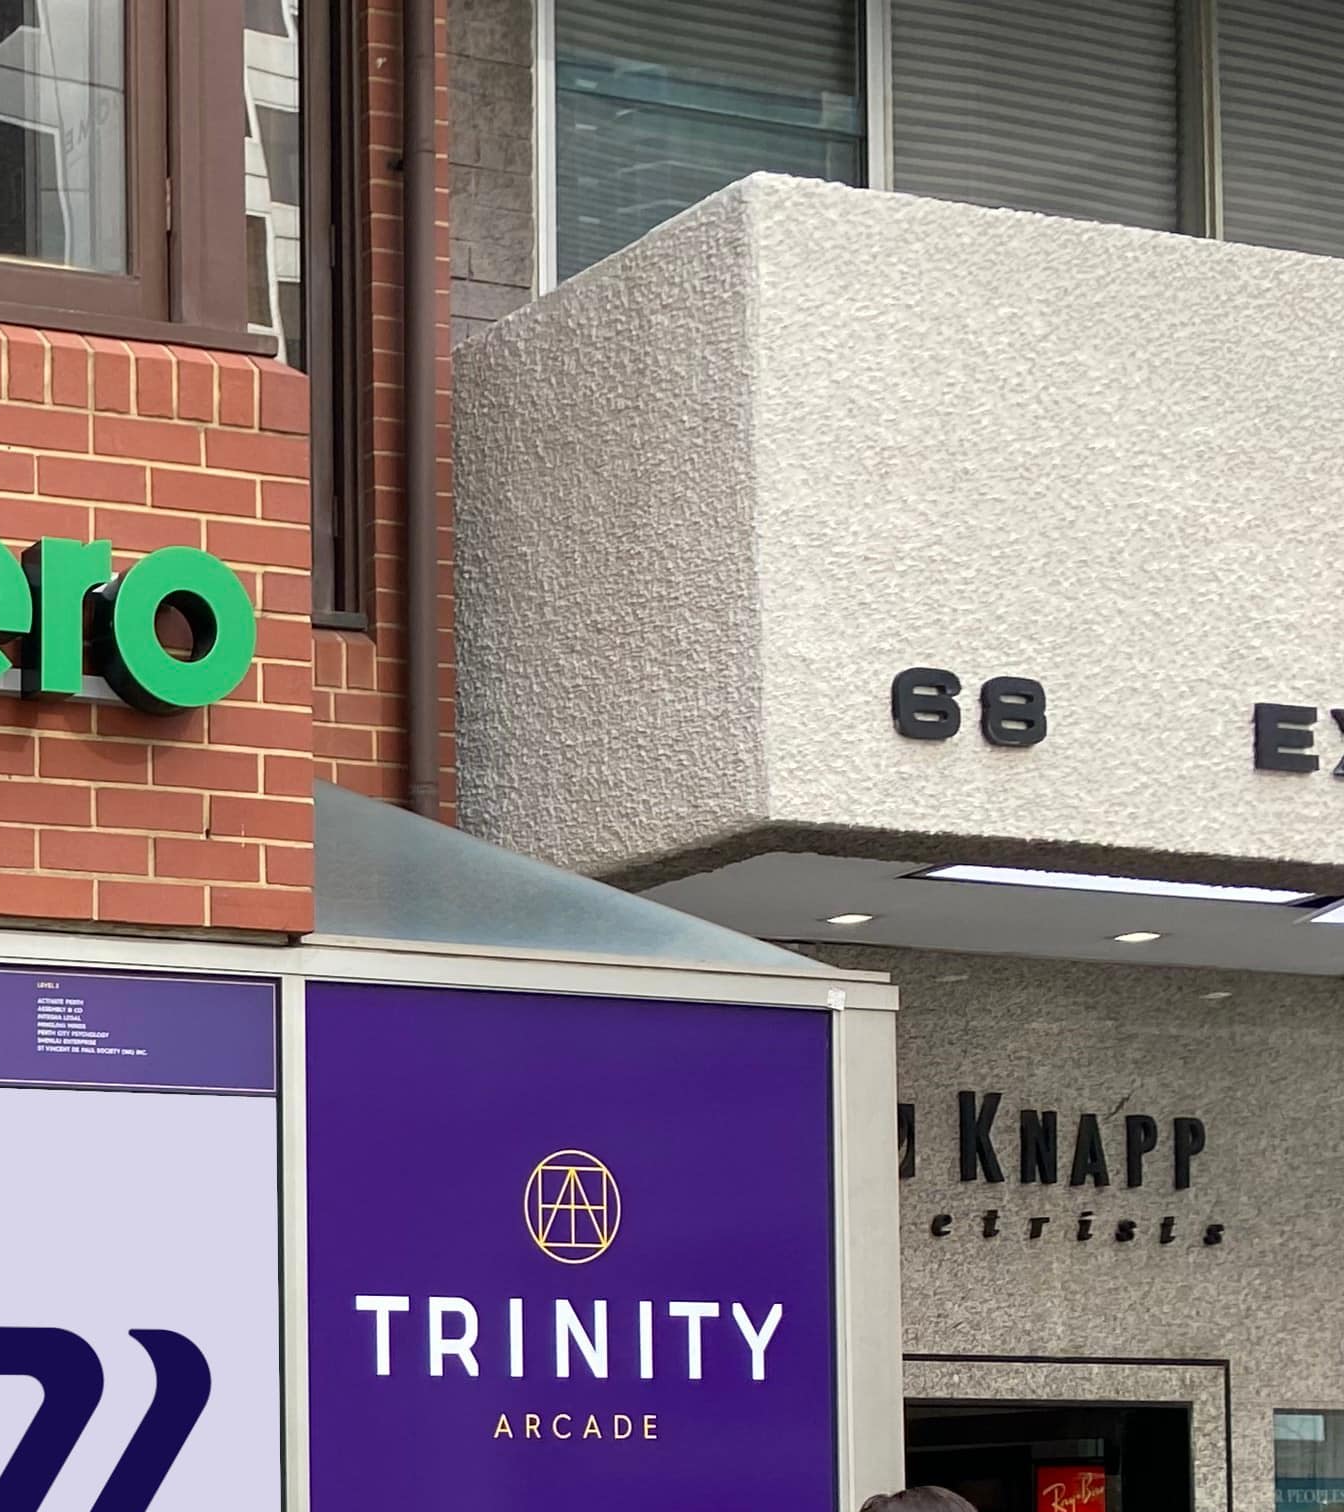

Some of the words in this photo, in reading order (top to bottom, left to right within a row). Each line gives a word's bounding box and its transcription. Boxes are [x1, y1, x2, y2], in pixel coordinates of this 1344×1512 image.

[891, 666, 1048, 748] 68
[958, 1091, 1206, 1190] KNAPP
[355, 1294, 784, 1381] TRINITY
[493, 1412, 658, 1440] ARCADE
